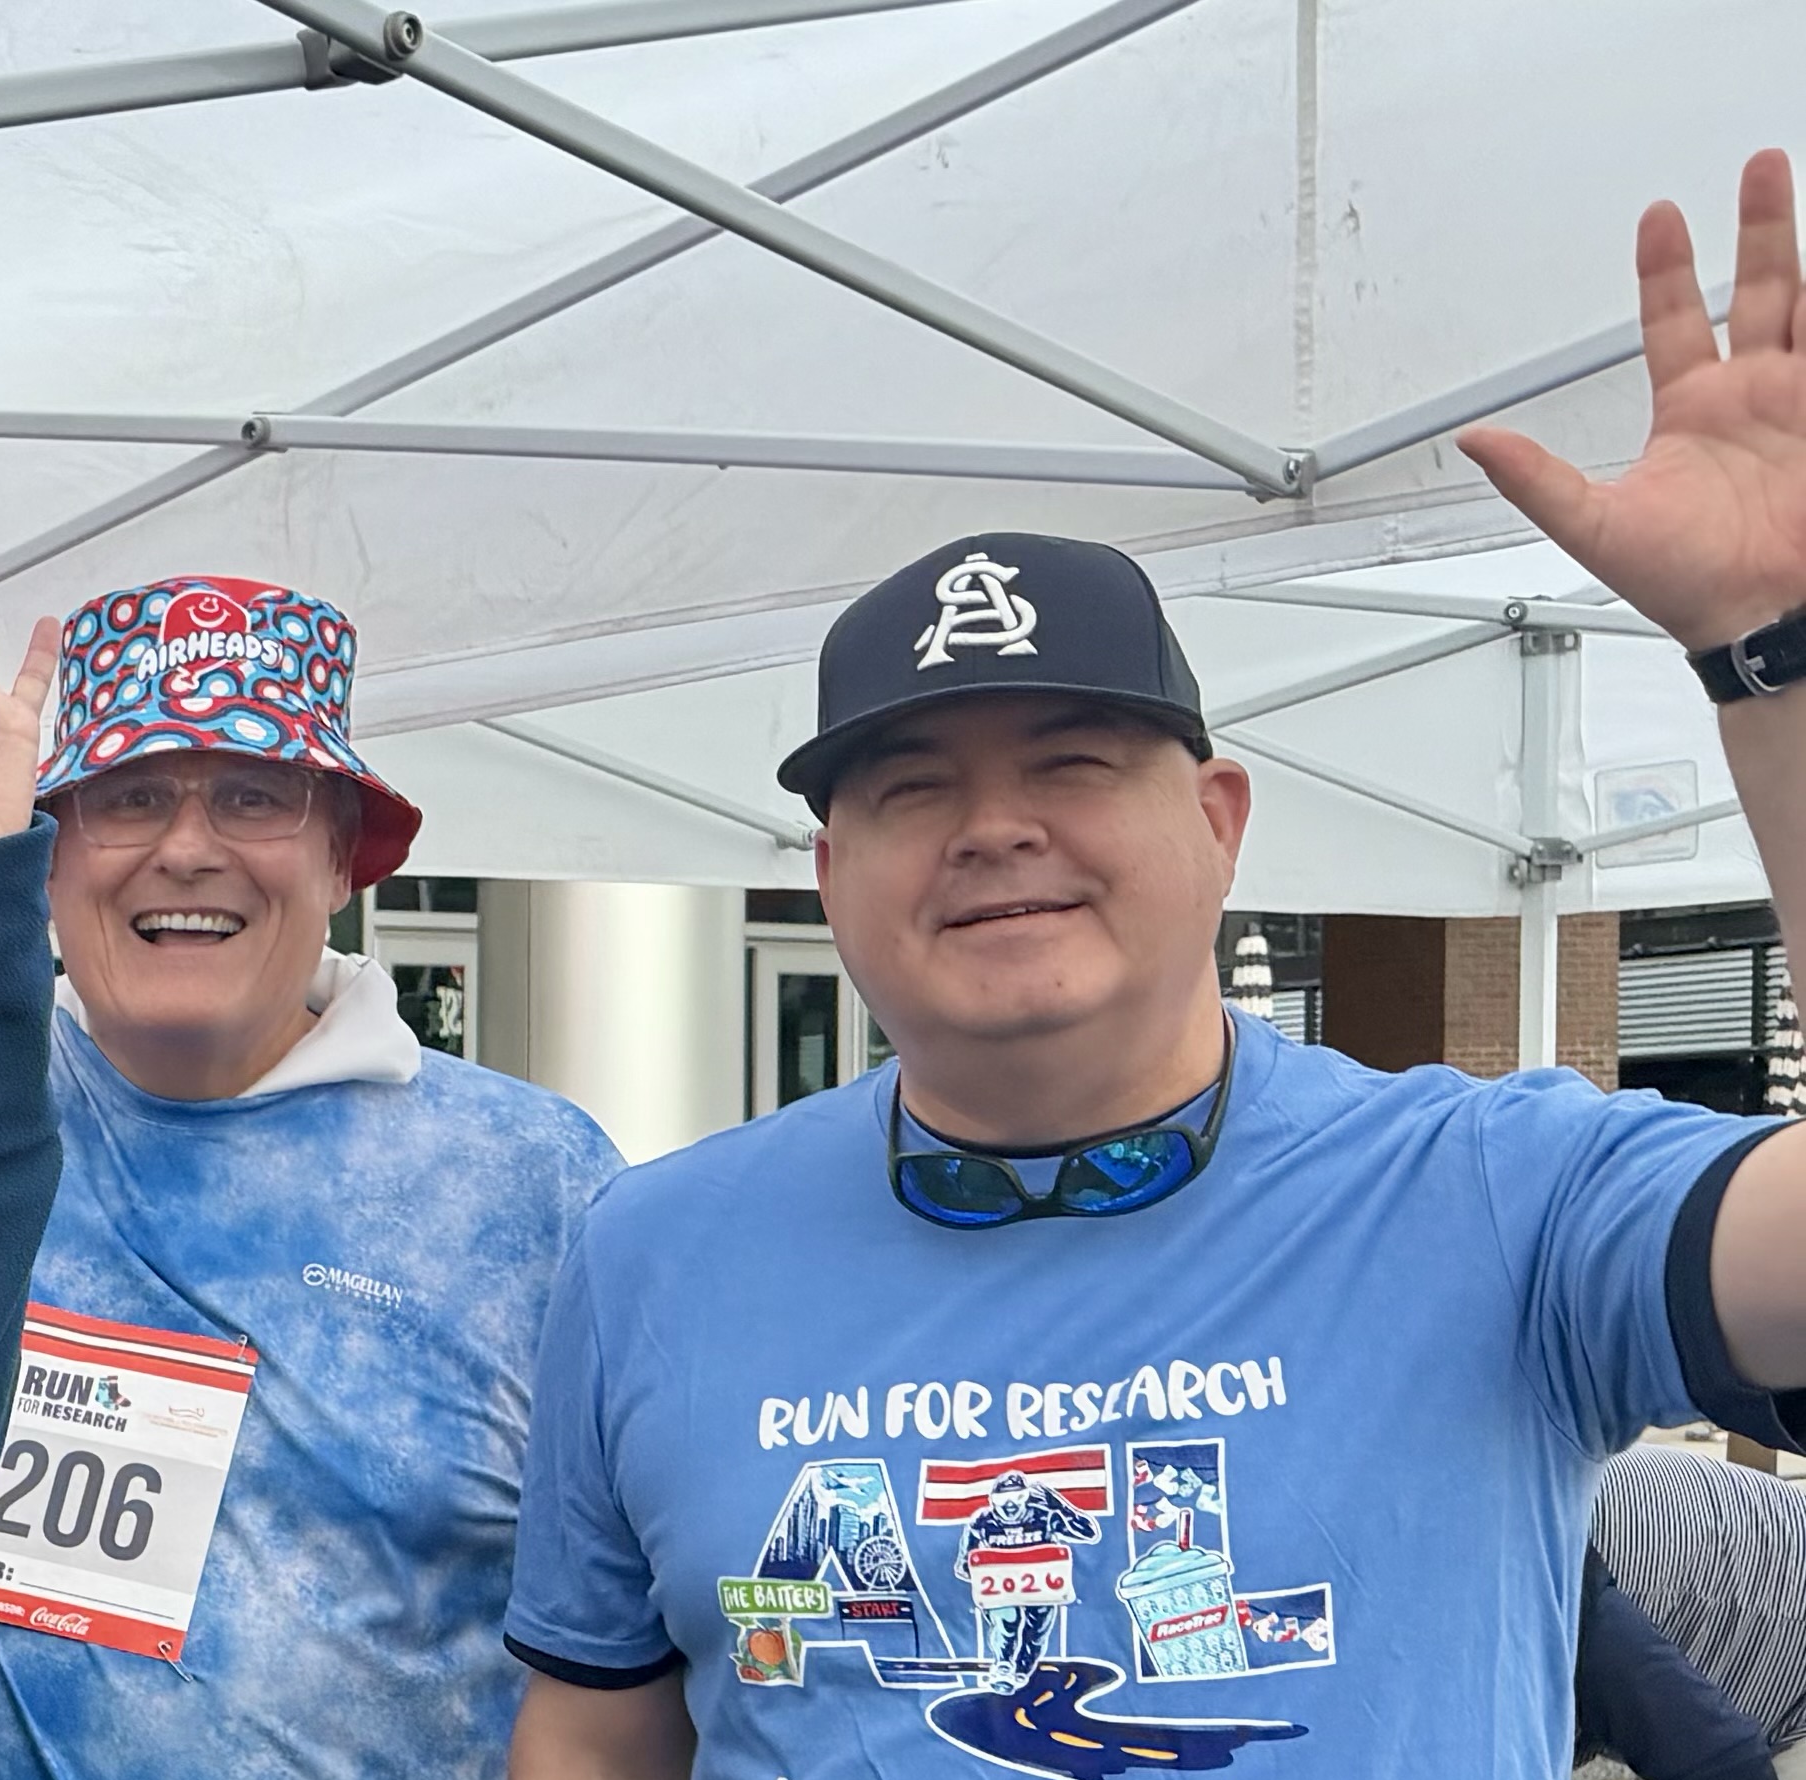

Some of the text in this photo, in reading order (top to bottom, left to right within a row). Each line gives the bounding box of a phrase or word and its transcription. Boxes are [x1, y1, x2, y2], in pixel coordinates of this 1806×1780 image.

[136, 630, 283, 682] AIRHEADS
[329, 1267, 403, 1303] MAGELLAN
[21, 1365, 94, 1406] RUN
[758, 1356, 1287, 1450] RUN FOR RESEARCH
[17, 1397, 40, 1415] FOR
[42, 1402, 127, 1432] RESEARCH
[722, 1584, 826, 1612] THE BATTERY
[981, 1572, 1064, 1595] 2026
[850, 1603, 899, 1617] START
[1157, 1612, 1222, 1638] RaceTrac
